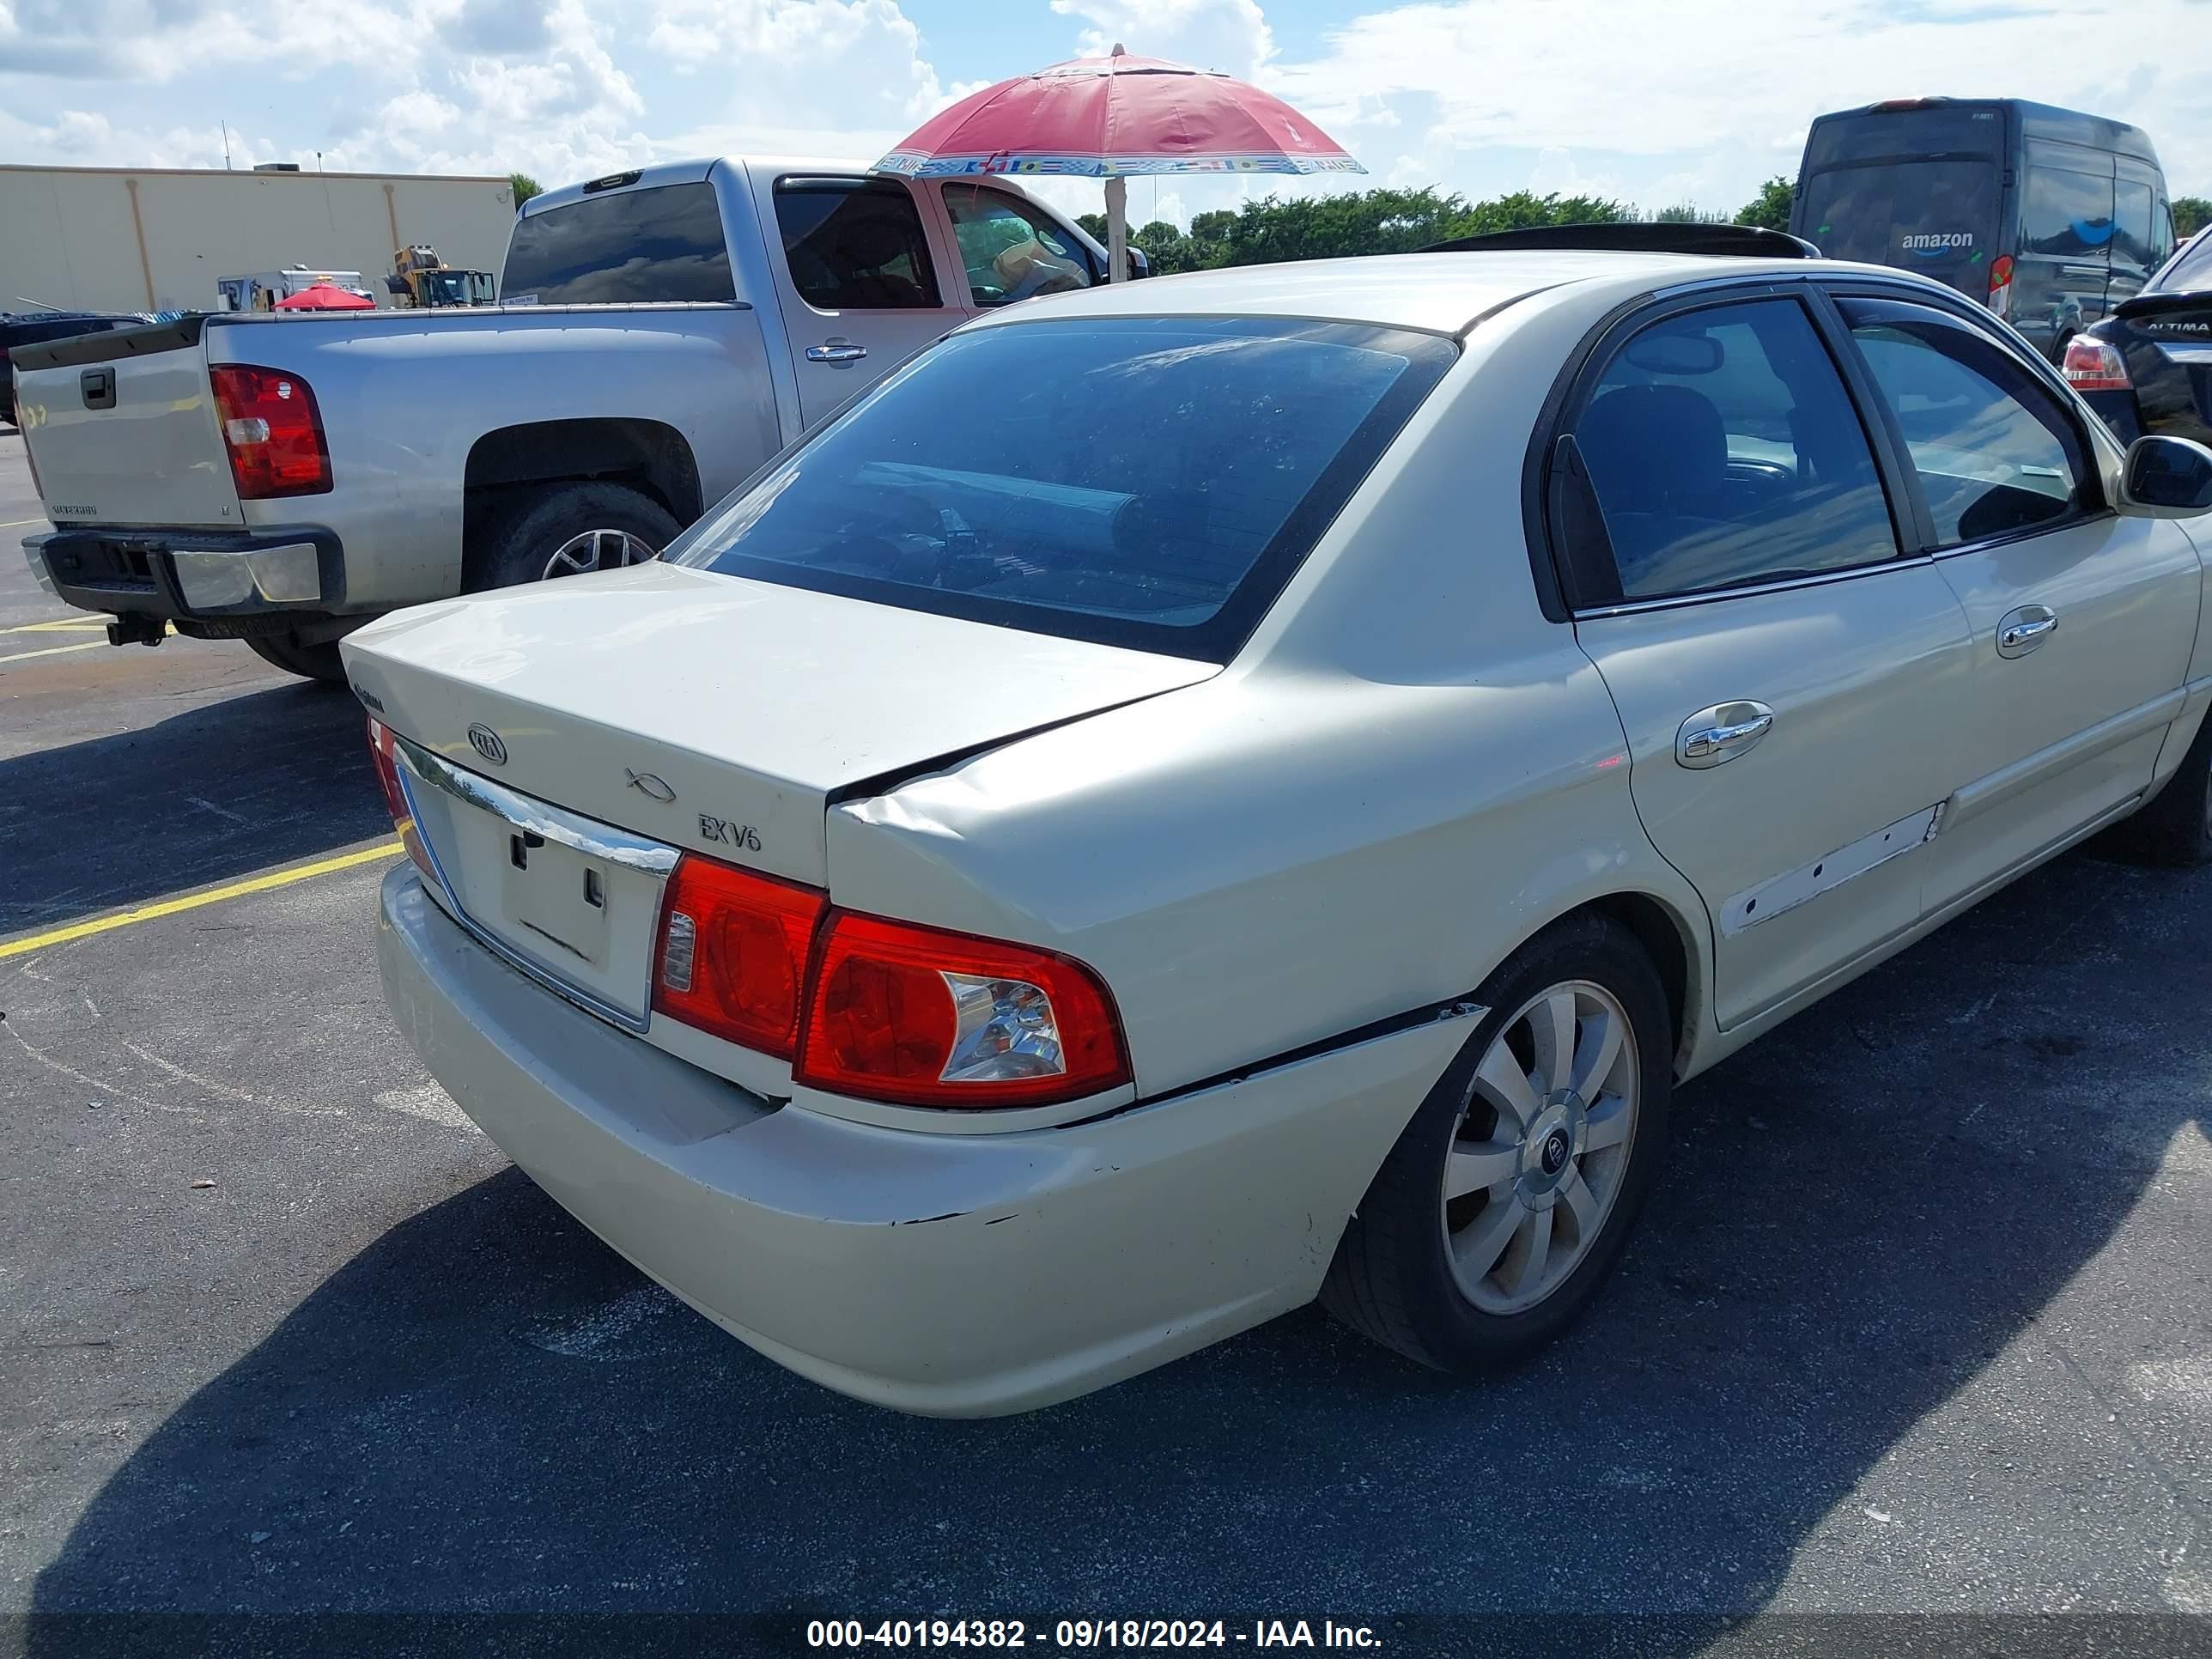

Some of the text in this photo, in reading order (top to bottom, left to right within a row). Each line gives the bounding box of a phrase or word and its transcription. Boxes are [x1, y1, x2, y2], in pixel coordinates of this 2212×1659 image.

[1902, 233, 1973, 249] amazon
[2148, 322, 2210, 332] ALTIMA
[471, 729, 503, 760] KIA
[699, 813, 762, 853] EX V6
